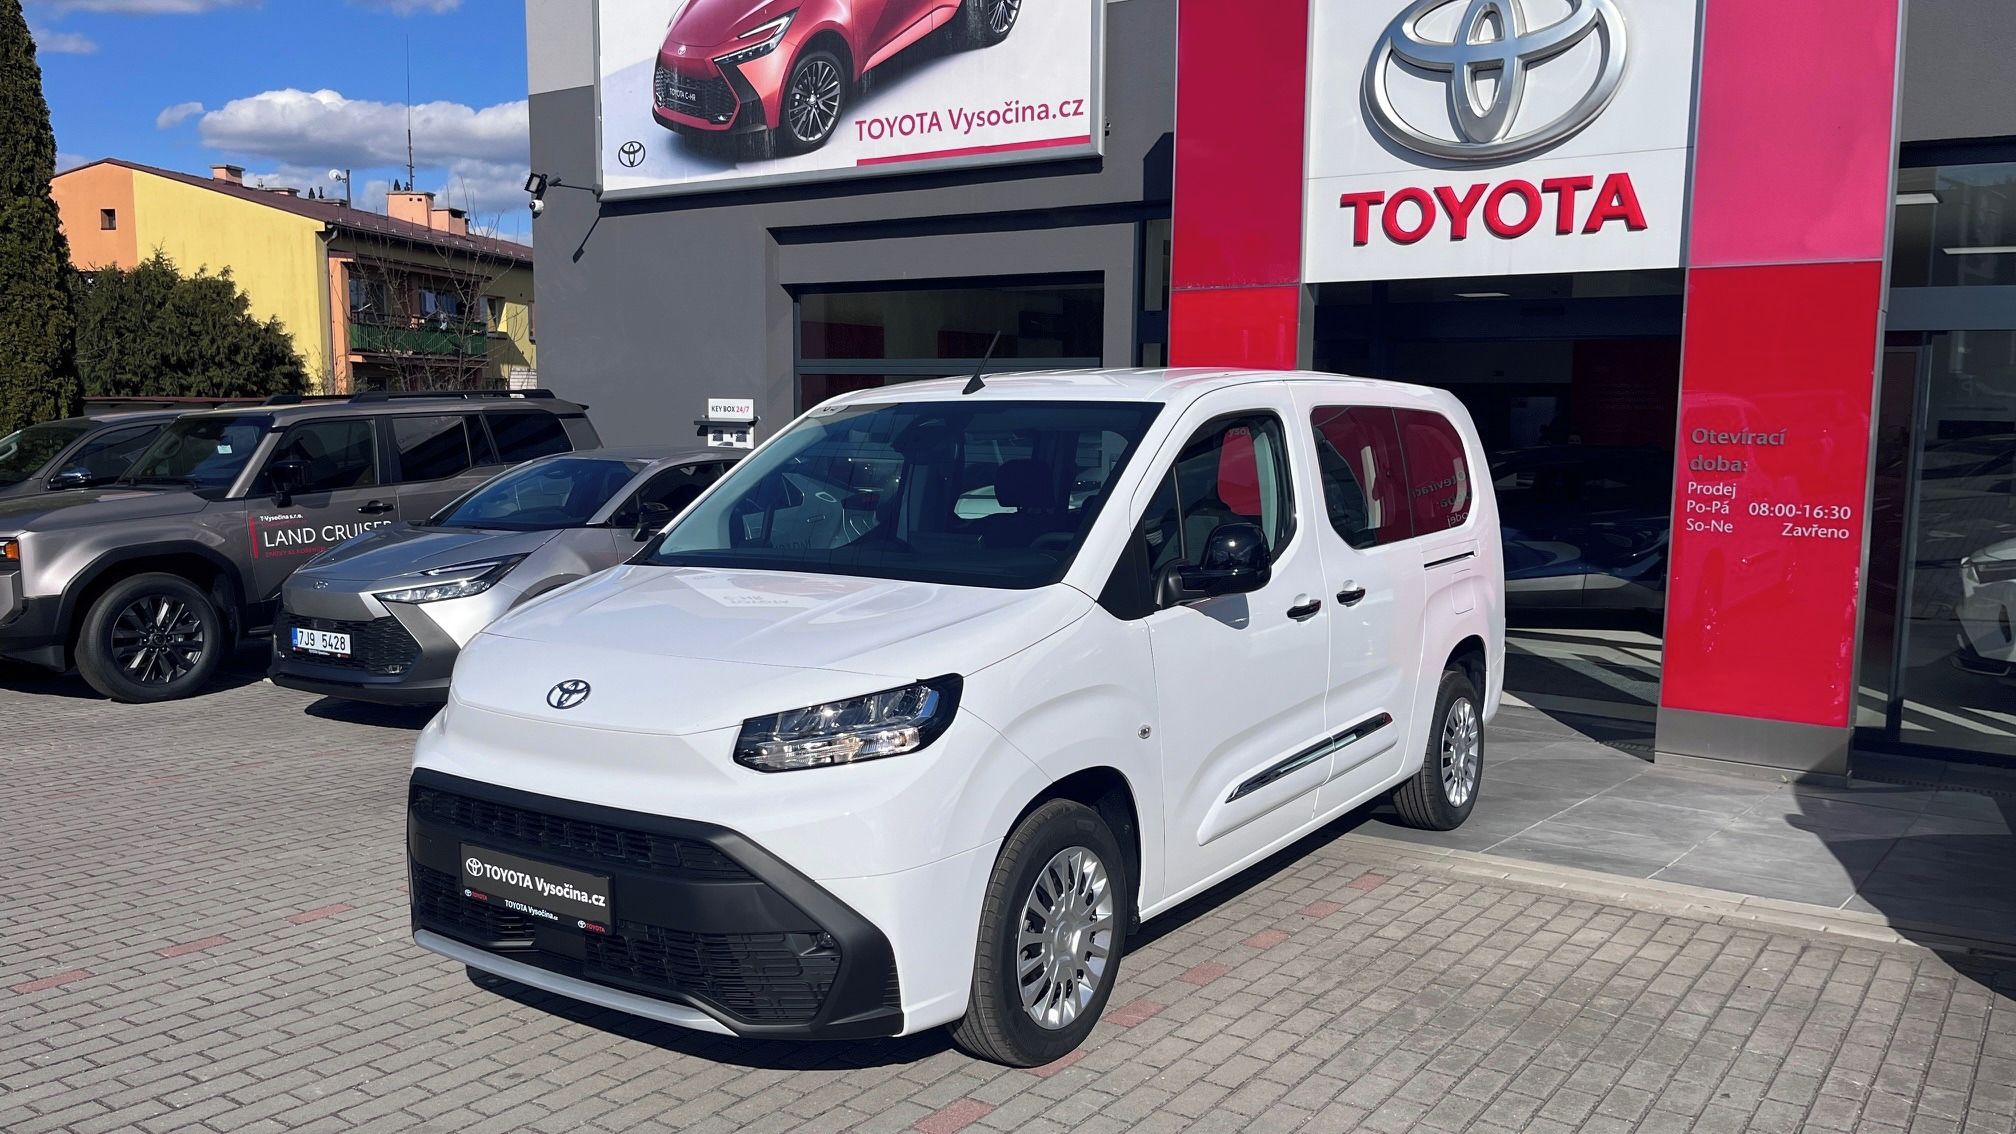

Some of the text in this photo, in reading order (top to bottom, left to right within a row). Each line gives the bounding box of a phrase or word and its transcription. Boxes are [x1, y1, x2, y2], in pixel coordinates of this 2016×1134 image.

[855, 99, 1084, 142] TOYOTA Vysočina.cz
[1340, 172, 1648, 247] TOYOTA
[711, 405, 722, 413] KEY
[723, 405, 735, 413] BOX
[1691, 428, 1787, 446] Otevírací
[1689, 455, 1748, 472] doba:
[1687, 481, 1737, 499] Prodej
[1686, 500, 1852, 520] Po-Pá 08:00-16:30
[264, 527, 316, 547] LAND
[1686, 519, 1850, 539] So-Ne Zavřeno
[299, 630, 346, 651] 7J9 5428
[484, 863, 606, 907] TOYOTA Vysočina.cz
[504, 899, 528, 913] TOYOTA
[586, 923, 605, 934] TOYOTA
